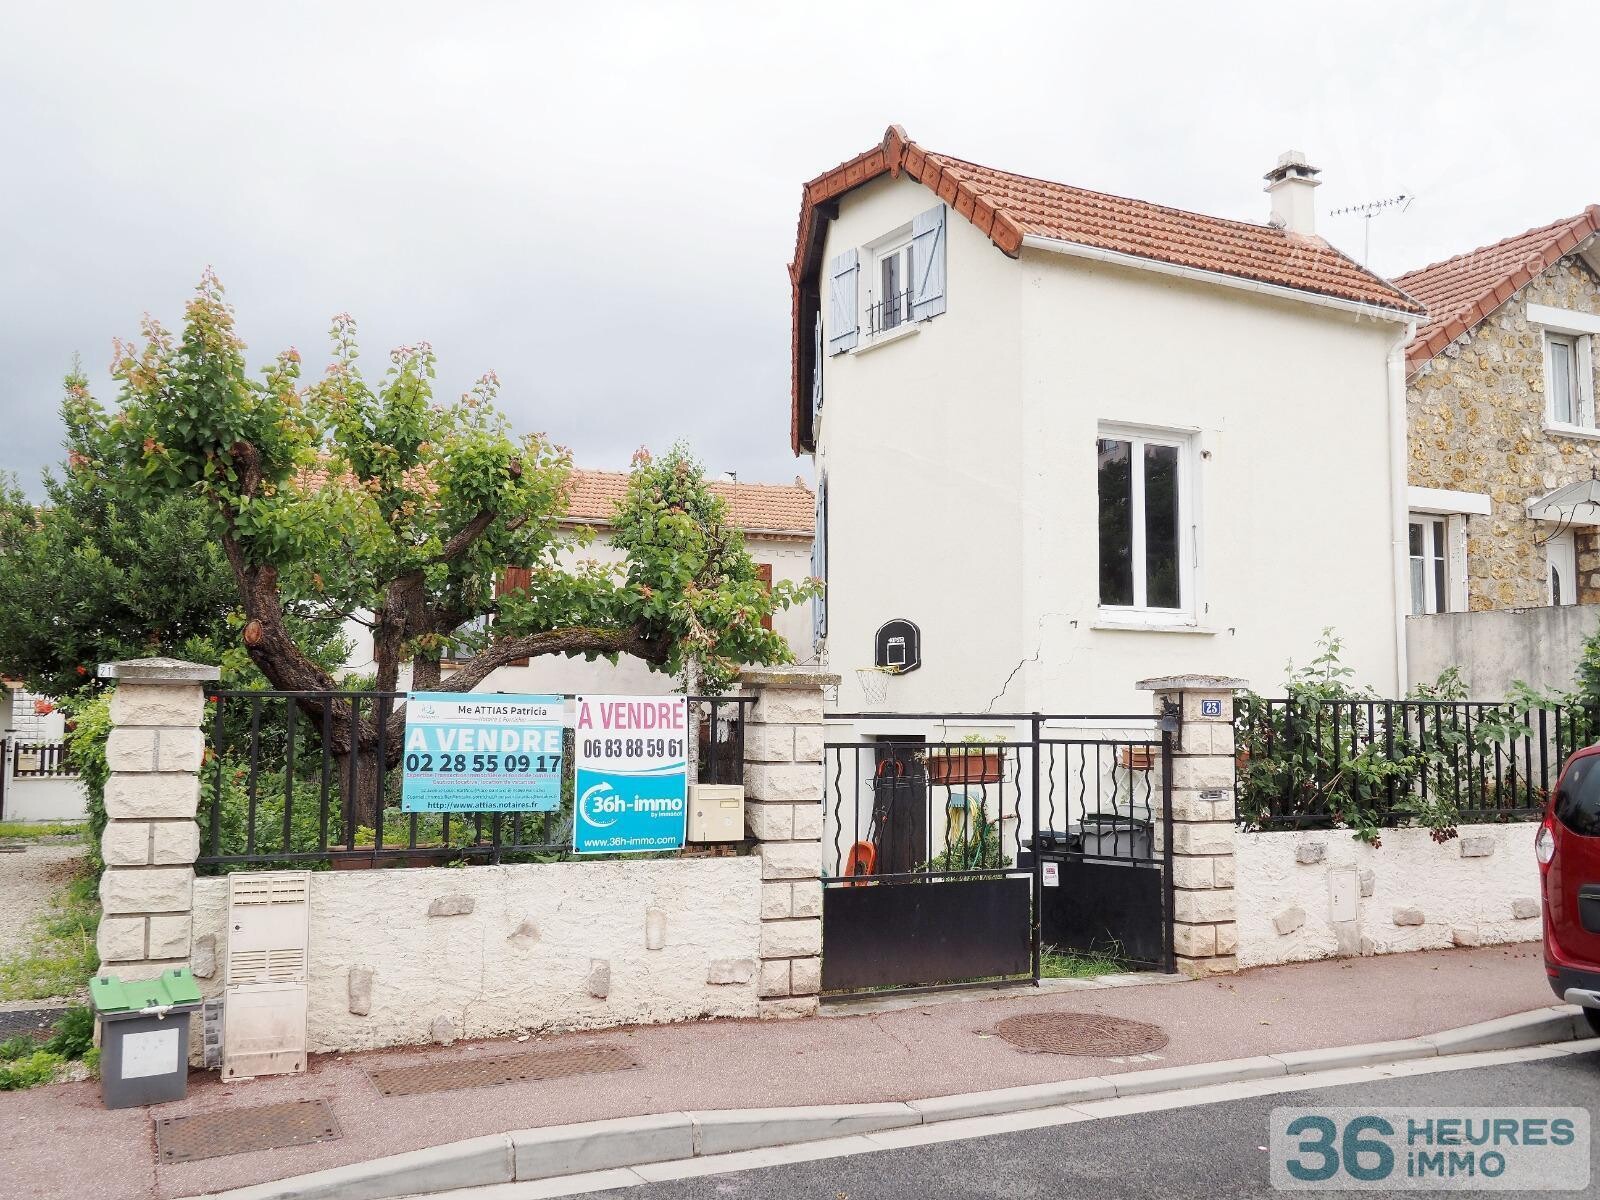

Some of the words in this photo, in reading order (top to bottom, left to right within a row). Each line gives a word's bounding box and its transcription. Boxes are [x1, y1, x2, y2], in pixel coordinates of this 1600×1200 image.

[458, 705, 472, 714] Me
[475, 706, 508, 715] ATTIAS
[511, 706, 547, 716] Patricia
[578, 702, 593, 730] A
[600, 702, 684, 730] VENDRE
[1206, 702, 1218, 714] 23
[407, 727, 428, 752] A
[435, 727, 560, 753] VENDRE
[583, 739, 602, 758] 06
[605, 739, 623, 758] 83
[626, 739, 644, 758] 88
[647, 739, 665, 758] 59
[668, 739, 684, 758] 61
[406, 754, 433, 772] 02
[439, 754, 466, 773] 28
[472, 754, 498, 773] 55
[504, 754, 531, 773] 09
[536, 755, 562, 773] 17
[427, 801, 538, 810] http://www.attias.notaires.fr
[592, 795, 683, 813] 36h-immo
[584, 835, 676, 847] www.36h-immo.com
